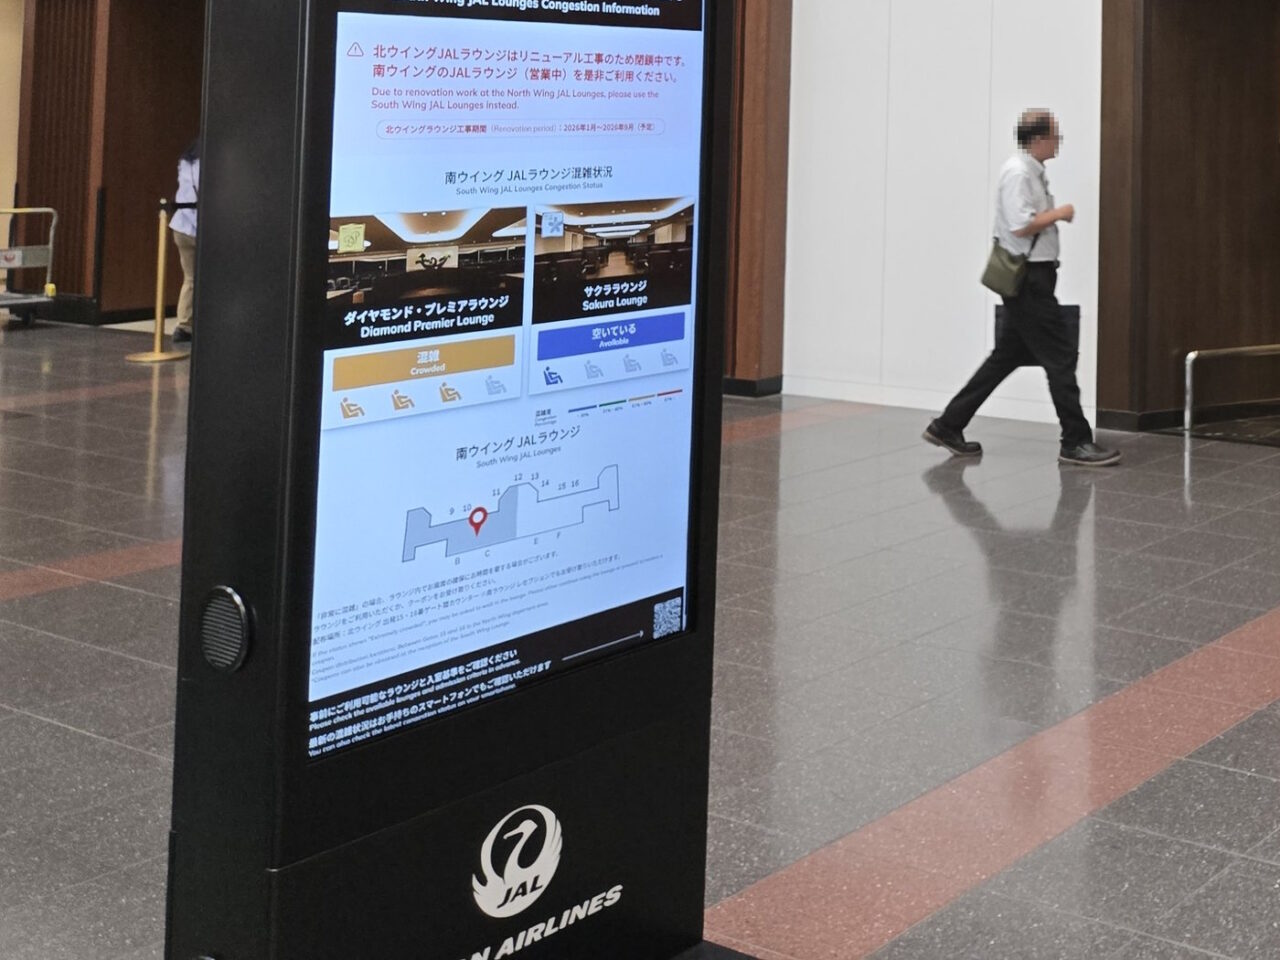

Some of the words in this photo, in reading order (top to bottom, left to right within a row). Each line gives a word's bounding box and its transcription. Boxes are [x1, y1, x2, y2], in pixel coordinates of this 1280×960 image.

[602, 1, 661, 16] Information
[371, 87, 391, 97] Due
[393, 87, 403, 97] to
[405, 87, 454, 98] renovation
[456, 88, 478, 98] work
[480, 89, 490, 98] at
[491, 88, 505, 98] the
[507, 89, 531, 98] North
[533, 89, 555, 100] Wing
[556, 89, 571, 100] JAL
[572, 90, 606, 100] Lounges,
[608, 91, 632, 100] please
[646, 91, 660, 99] the
[371, 99, 399, 110] South
[401, 100, 427, 111] Wing
[429, 100, 445, 111] JAL
[447, 100, 484, 111] Lounges
[485, 100, 520, 110] instead.
[445, 170, 505, 185] 南ウイング
[507, 165, 614, 182] JALラウンジ混雑状況
[456, 187, 478, 196] South
[479, 186, 499, 196] Wing
[500, 185, 513, 195] JAL
[514, 184, 543, 194] Lounges
[544, 182, 582, 193] Congestion
[582, 181, 604, 190] Status
[583, 280, 649, 298] サクララウンジ
[343, 294, 511, 326] ダイヤモンド・プレミアラウンジ
[582, 299, 616, 312] Sakura
[617, 294, 649, 308] Lounge
[360, 321, 412, 339] Diamond
[413, 316, 455, 333] Premier
[456, 313, 495, 329] Lounge
[591, 323, 638, 340] 空いている
[599, 337, 630, 348] Available
[410, 363, 446, 376] Crowded
[456, 436, 515, 461] 南ウイング
[517, 425, 581, 448] JALラウンジ
[476, 457, 498, 469] South
[499, 453, 518, 464] Wing
[519, 450, 532, 462] JAL
[533, 445, 562, 458] Lounges
[514, 473, 523, 482] 12
[531, 472, 539, 481] 13
[541, 479, 550, 488] 14
[492, 488, 501, 497] 11
[449, 507, 455, 516] 9
[463, 503, 472, 513] 10
[497, 875, 544, 909] JAL
[494, 884, 624, 960] AIRLINES
